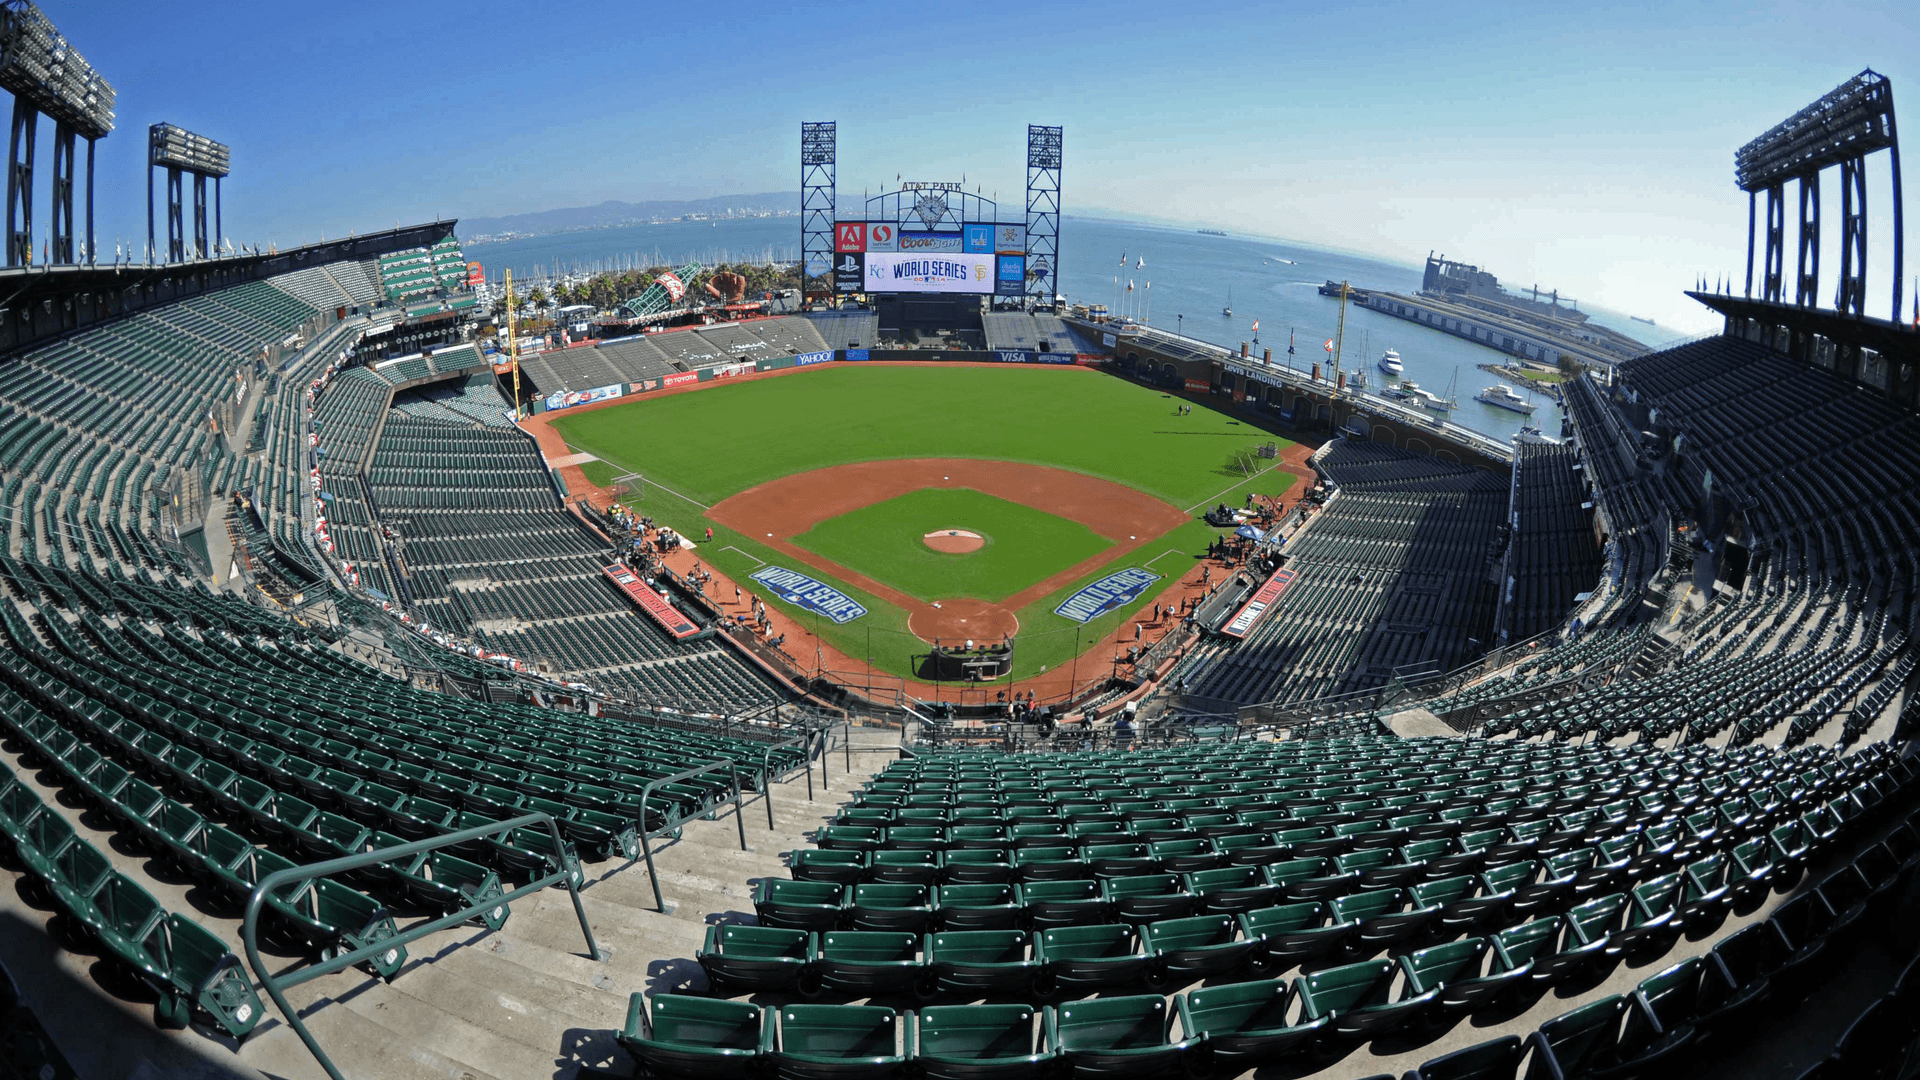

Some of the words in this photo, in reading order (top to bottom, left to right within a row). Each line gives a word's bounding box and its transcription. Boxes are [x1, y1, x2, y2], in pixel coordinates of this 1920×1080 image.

[902, 182, 929, 192] AT&T
[932, 183, 961, 193] PARK
[893, 261, 929, 279] WORLD
[932, 261, 967, 280] SERIES
[799, 351, 832, 365] YAHOO!
[1001, 352, 1026, 362] VISA
[673, 374, 697, 384] TOYOTA
[1246, 370, 1282, 388] LANDING
[753, 567, 821, 594] WORLD
[804, 587, 864, 622] SERIES
[1057, 587, 1114, 621] WORLD
[1095, 569, 1158, 595] SERIES
[239, 1006, 250, 1019] 12
